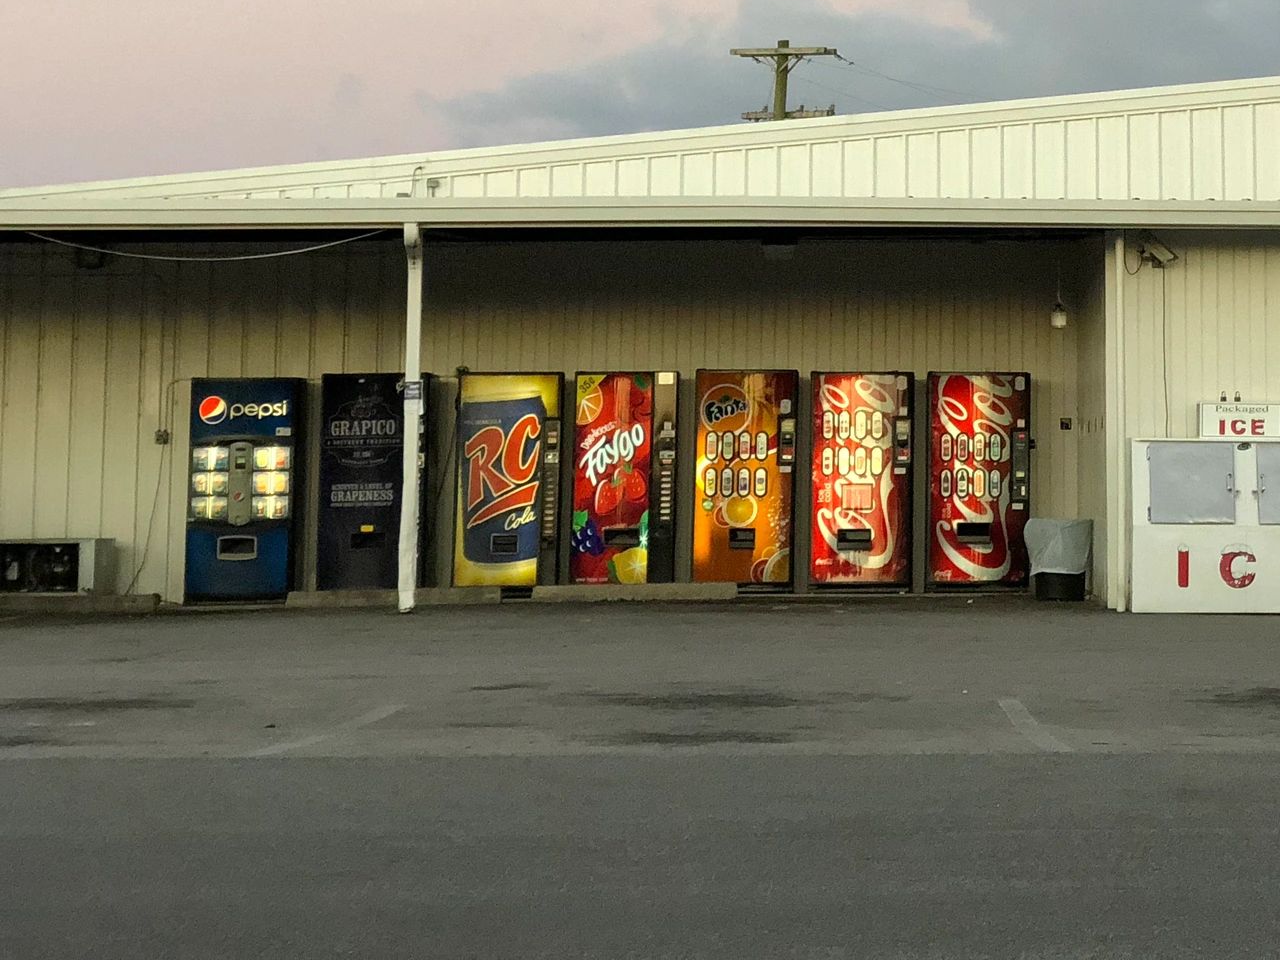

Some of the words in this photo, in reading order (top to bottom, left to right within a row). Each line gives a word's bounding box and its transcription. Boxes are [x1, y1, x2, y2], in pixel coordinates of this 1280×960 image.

[230, 400, 288, 420] pepsi
[704, 399, 748, 424] Fanta
[1215, 405, 1269, 414] Packaged
[331, 420, 396, 436] GRAPICO
[1218, 418, 1265, 435] ICE
[464, 413, 541, 512] RC
[579, 423, 645, 487] Faygo
[331, 489, 394, 501] GRAPENESS
[504, 506, 536, 531] Cola
